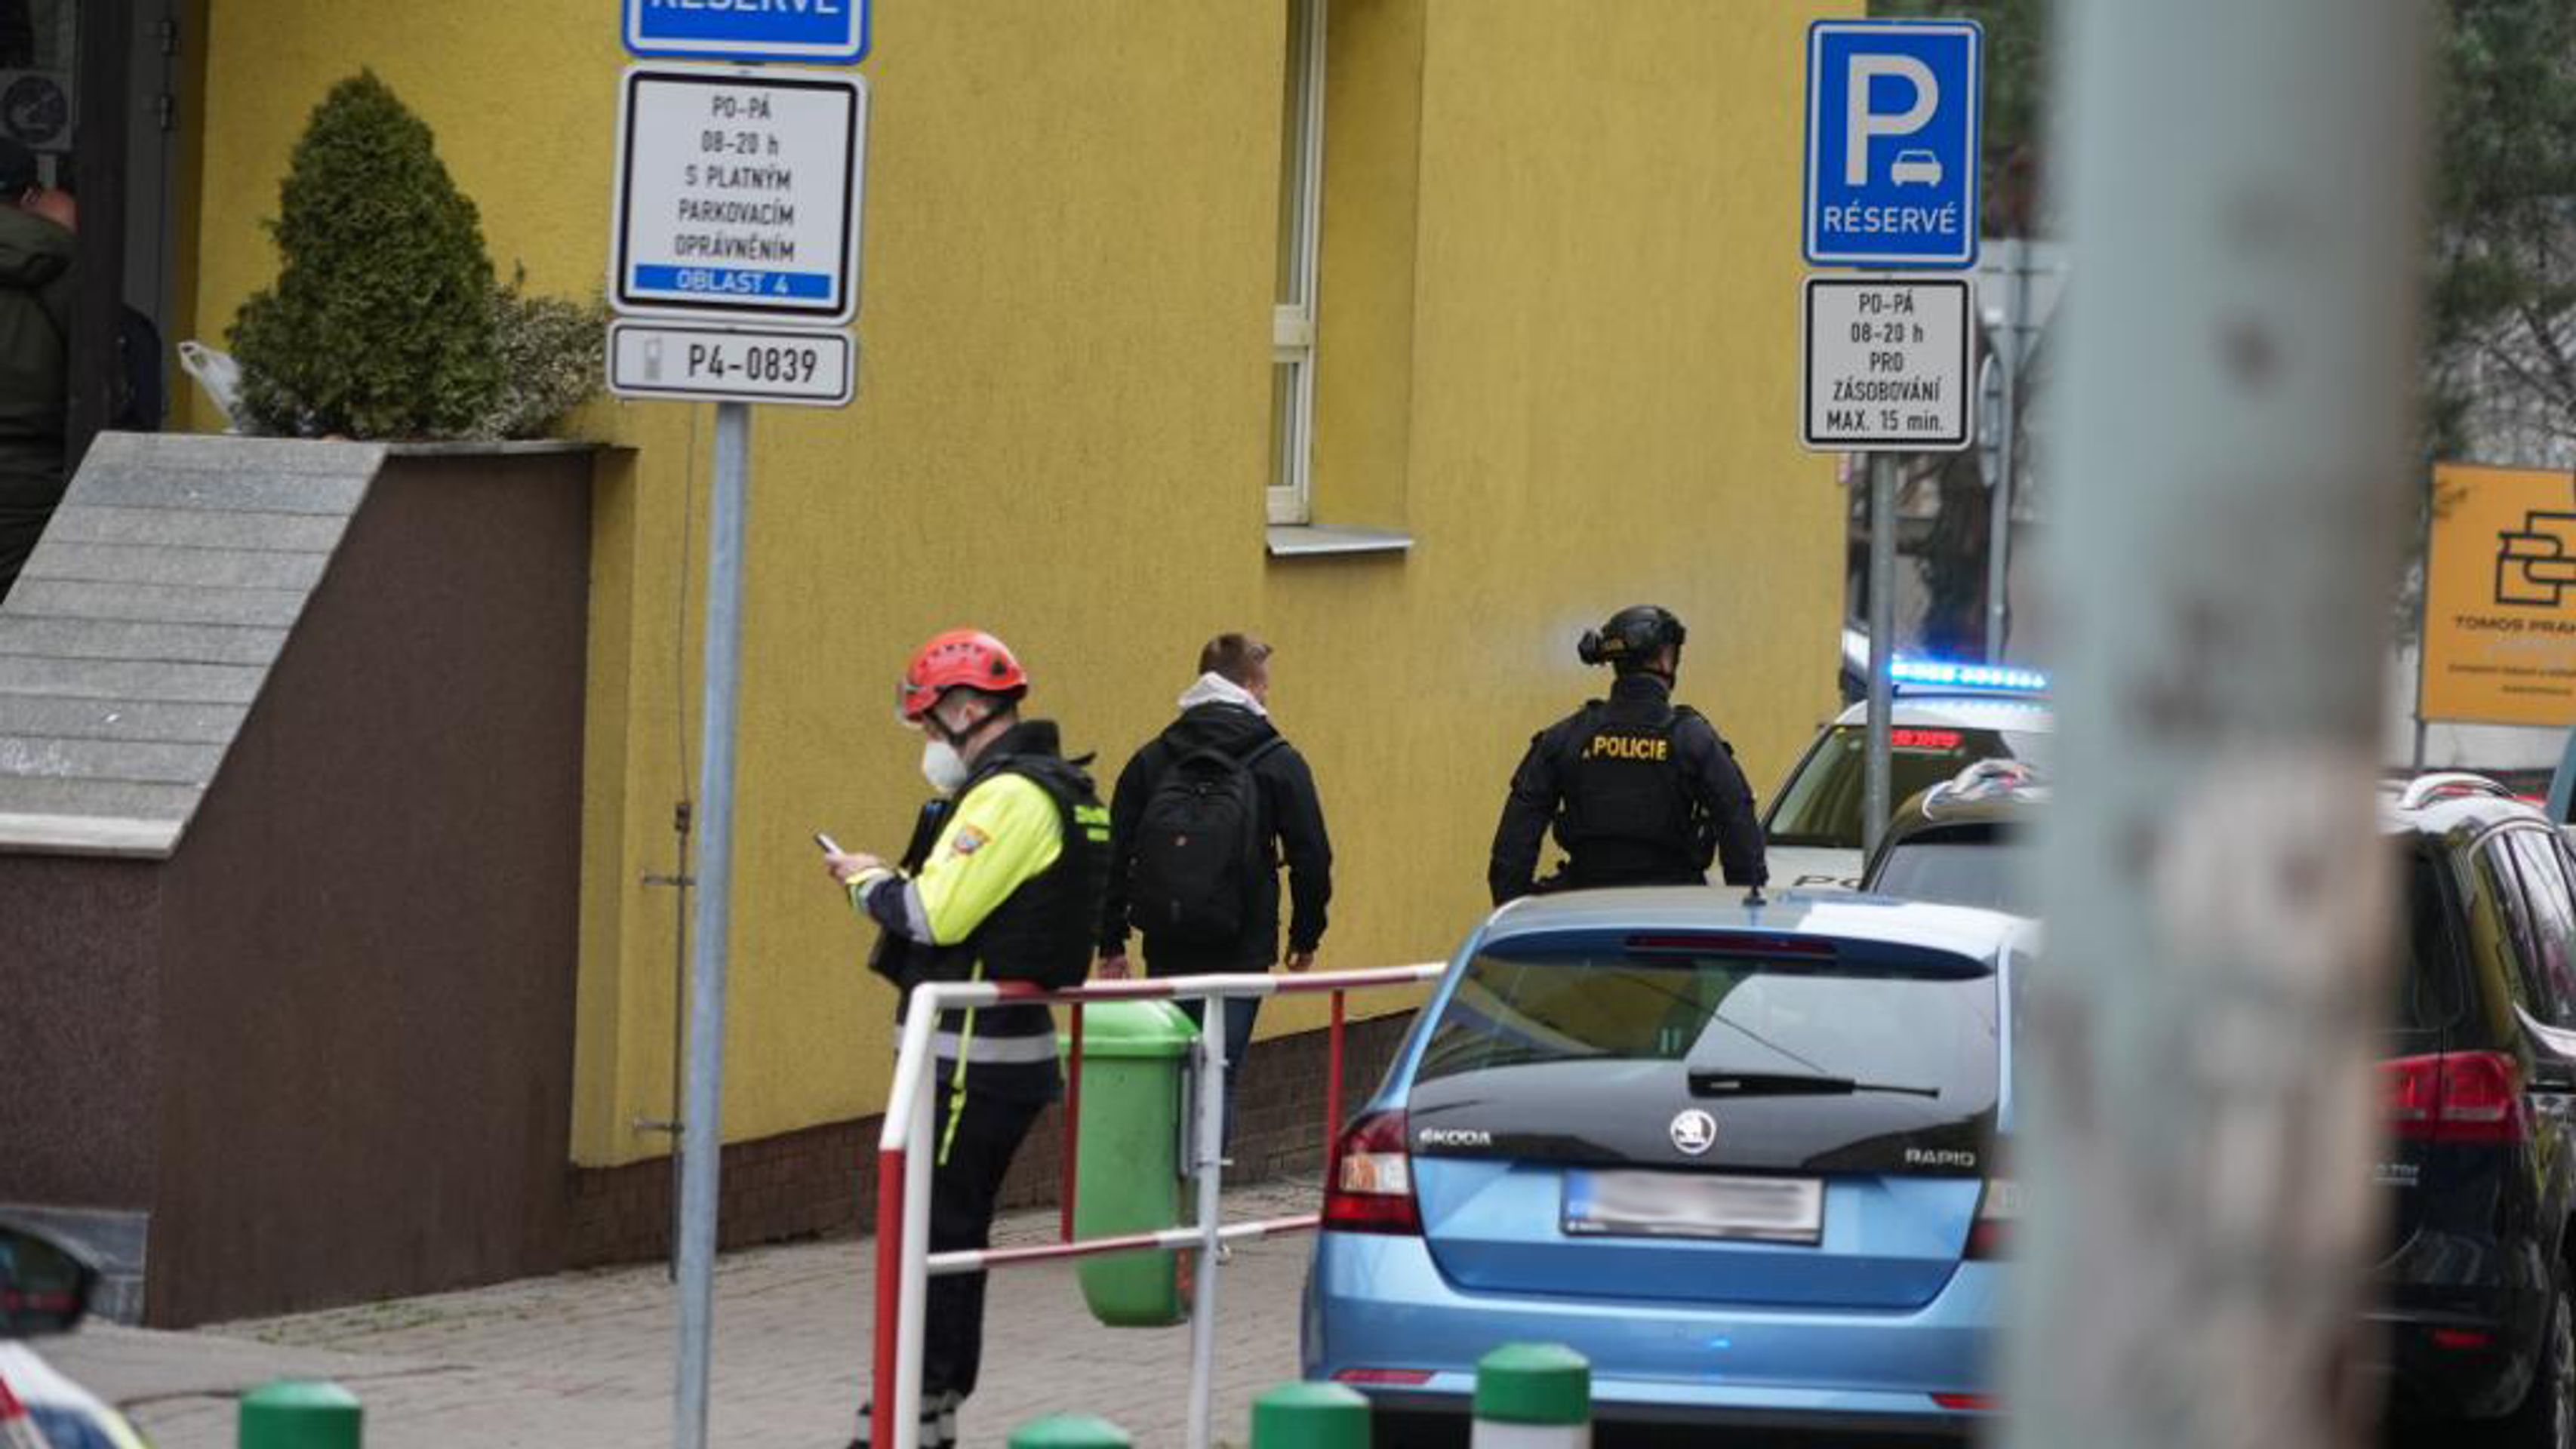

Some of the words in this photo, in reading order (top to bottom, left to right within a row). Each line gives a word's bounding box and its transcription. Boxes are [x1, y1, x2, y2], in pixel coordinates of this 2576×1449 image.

[712, 93, 771, 118] PO-PÁ
[700, 130, 759, 154] 08-20
[768, 134, 778, 155] h
[685, 165, 697, 186] S
[706, 164, 791, 189] PLATNÝM
[679, 198, 793, 224] PARKOVACÍM
[1823, 199, 1957, 234] RÉSERVÉ
[675, 232, 795, 261] OPRÁVNĚNÍM
[676, 270, 763, 294] OBLAST
[773, 276, 789, 294] 4
[1858, 288, 1914, 314] PO-PÁ
[1851, 322, 1905, 343] 08-20
[1913, 323, 1924, 343] h
[688, 343, 817, 383] P4-0839
[1870, 352, 1904, 372] PRO
[1833, 376, 1941, 401] ZÁSOBOVÁNÍ
[1826, 410, 1870, 432] MAX.
[1881, 410, 1899, 431] 15
[1907, 411, 1944, 432] min.
[1593, 735, 1667, 761] POLICIE
[1904, 1147, 1976, 1167] RAPID
